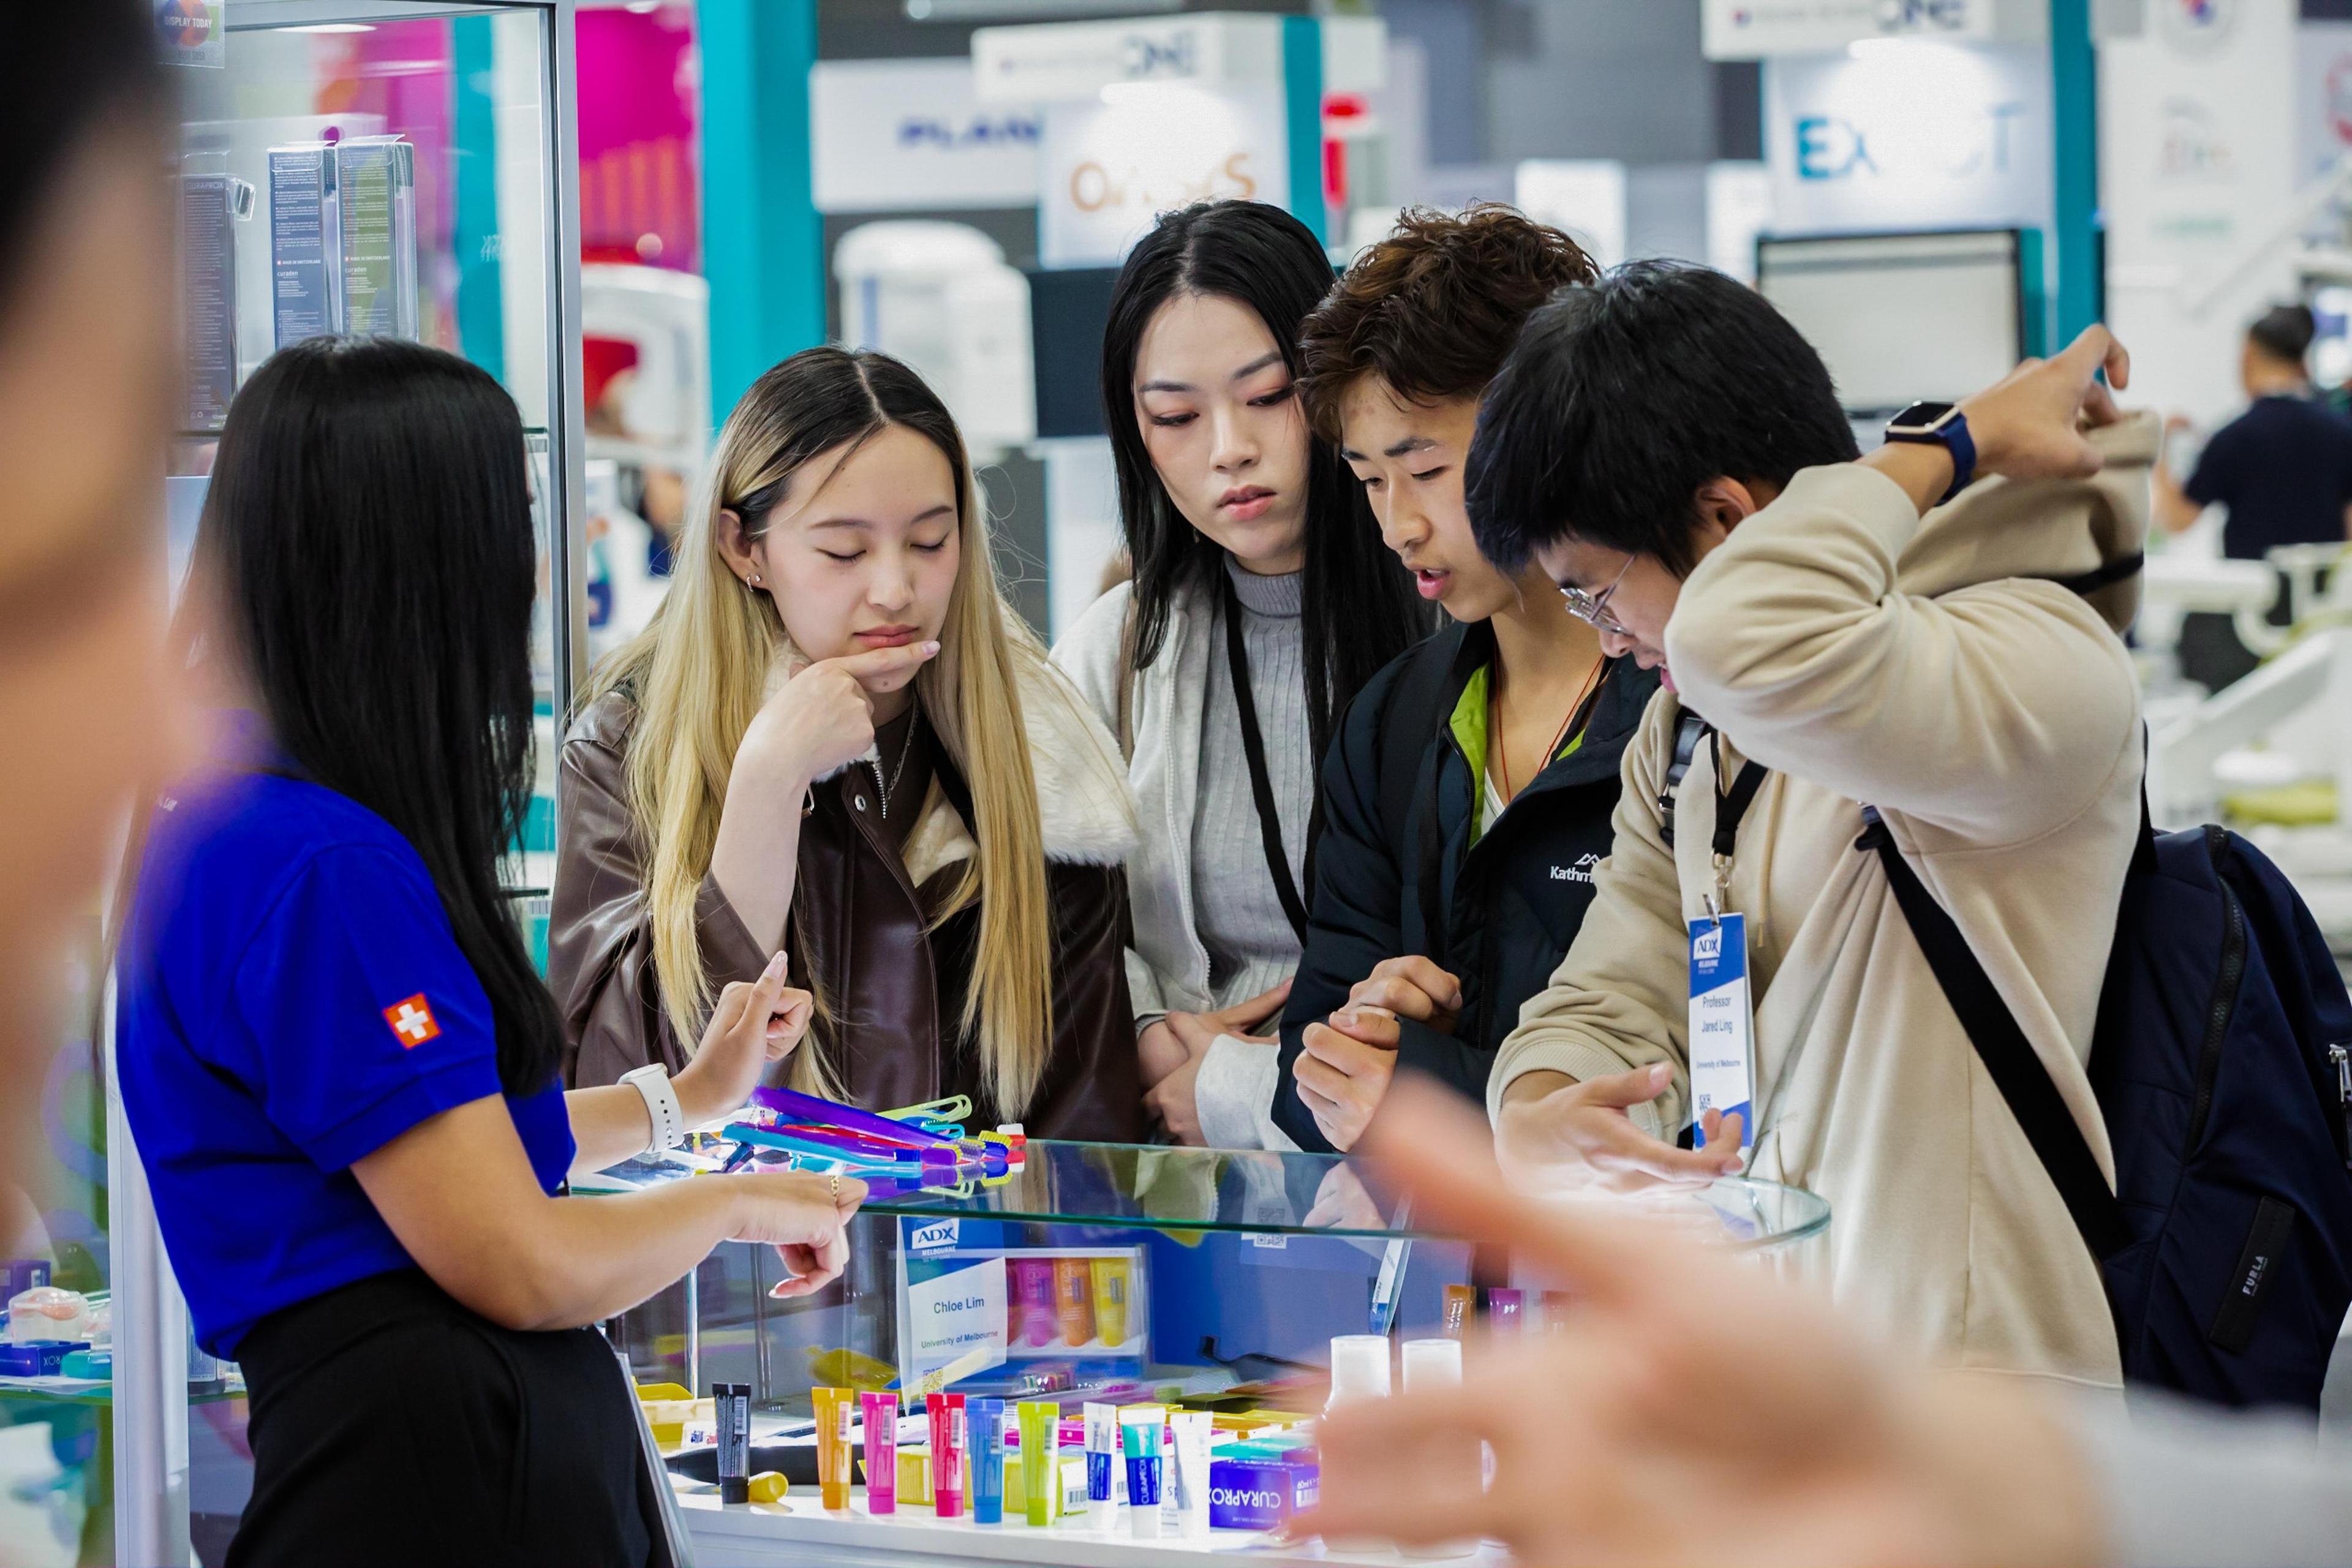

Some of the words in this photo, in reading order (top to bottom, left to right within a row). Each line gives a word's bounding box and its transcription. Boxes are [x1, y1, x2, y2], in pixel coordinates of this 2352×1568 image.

[165, 17, 190, 27] DISPLAY
[192, 18, 213, 28] TODAY
[1550, 865, 1593, 883] Kathm
[1697, 939, 1720, 955] ADX
[1703, 997, 1731, 1009] Professor
[1702, 1020, 1718, 1033] Jared
[1719, 1019, 1732, 1034] Ling
[918, 1227, 957, 1243] ADX
[922, 1245, 956, 1256] MELBOURNE
[2242, 1256, 2264, 1294] FURLA
[934, 1301, 962, 1314] Chloe
[967, 1297, 984, 1308] Lim
[921, 1337, 954, 1349] University
[964, 1330, 998, 1341] Melbourne
[1139, 1458, 1150, 1504] CURAPROX
[1209, 1487, 1281, 1509] CURAPRO
